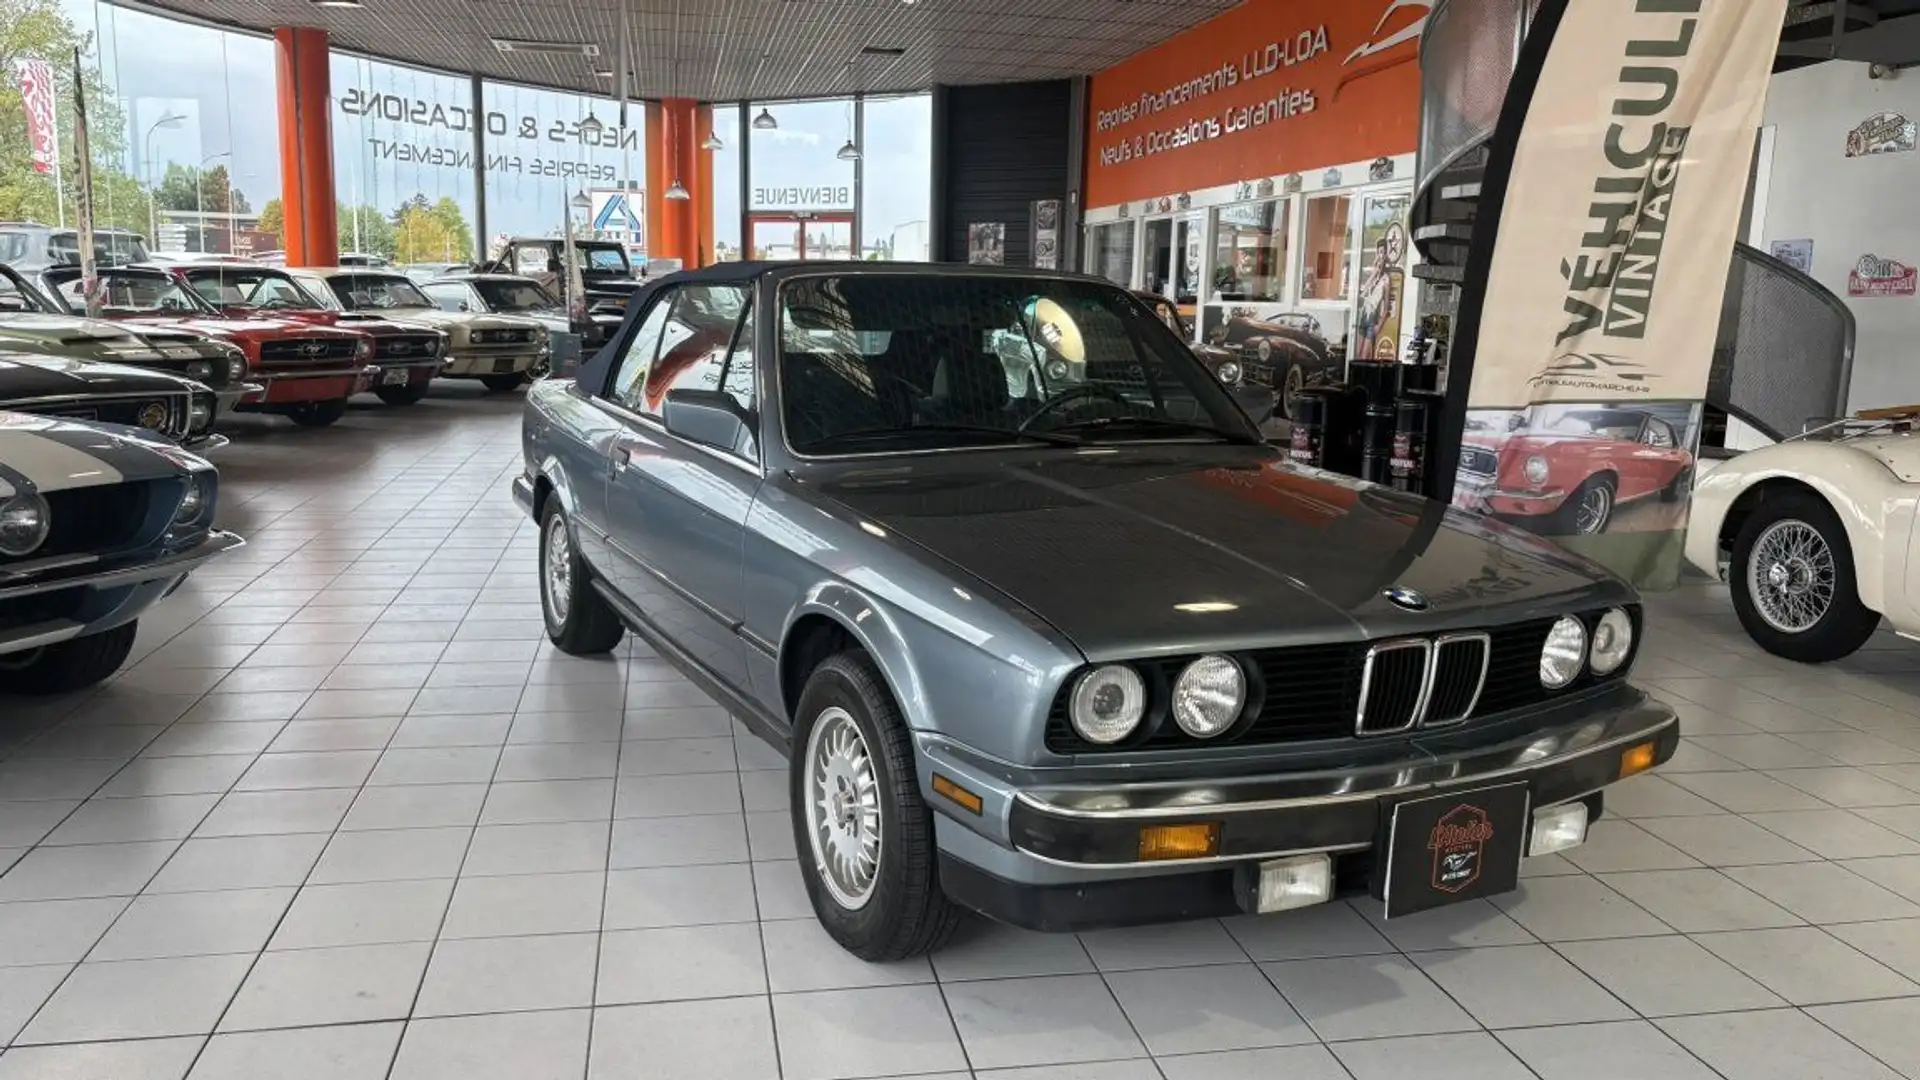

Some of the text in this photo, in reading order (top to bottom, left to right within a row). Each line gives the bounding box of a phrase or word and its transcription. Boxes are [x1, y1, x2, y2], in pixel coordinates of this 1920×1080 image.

[1096, 101, 1139, 132] Reprise
[1099, 87, 1316, 167] Neufs & Occasions Garanties
